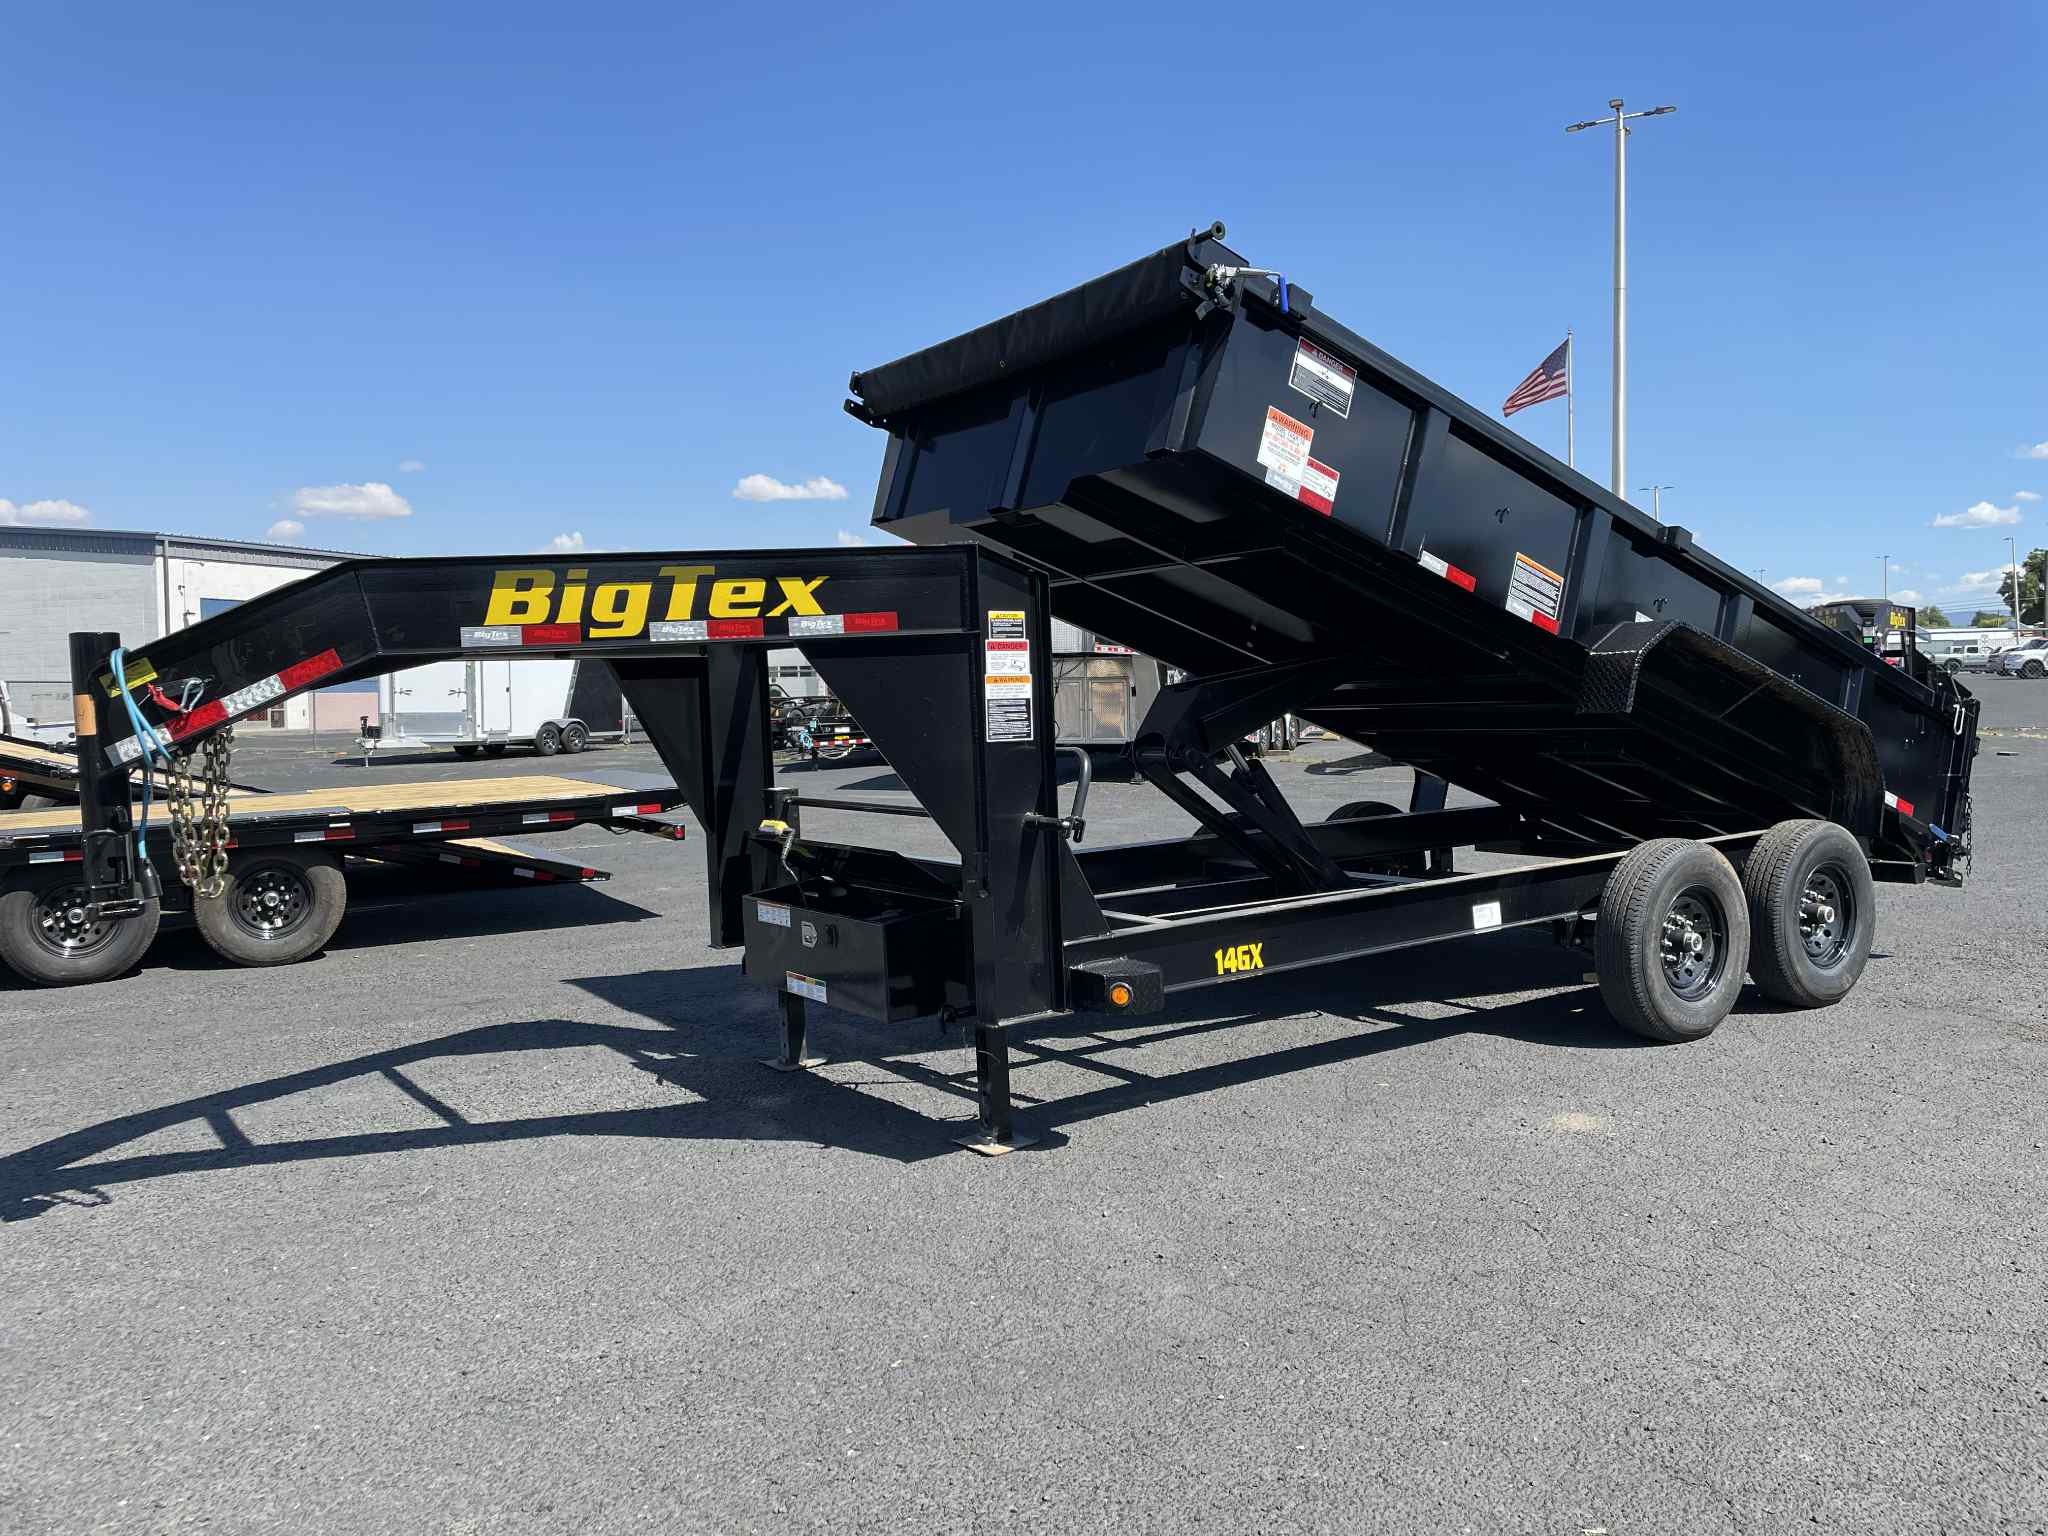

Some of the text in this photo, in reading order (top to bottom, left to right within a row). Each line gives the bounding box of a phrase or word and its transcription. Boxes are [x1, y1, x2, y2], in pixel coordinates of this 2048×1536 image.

[1279, 415, 1310, 438] WARNING
[483, 565, 831, 638] BigTex
[1215, 943, 1264, 975] 14GX
